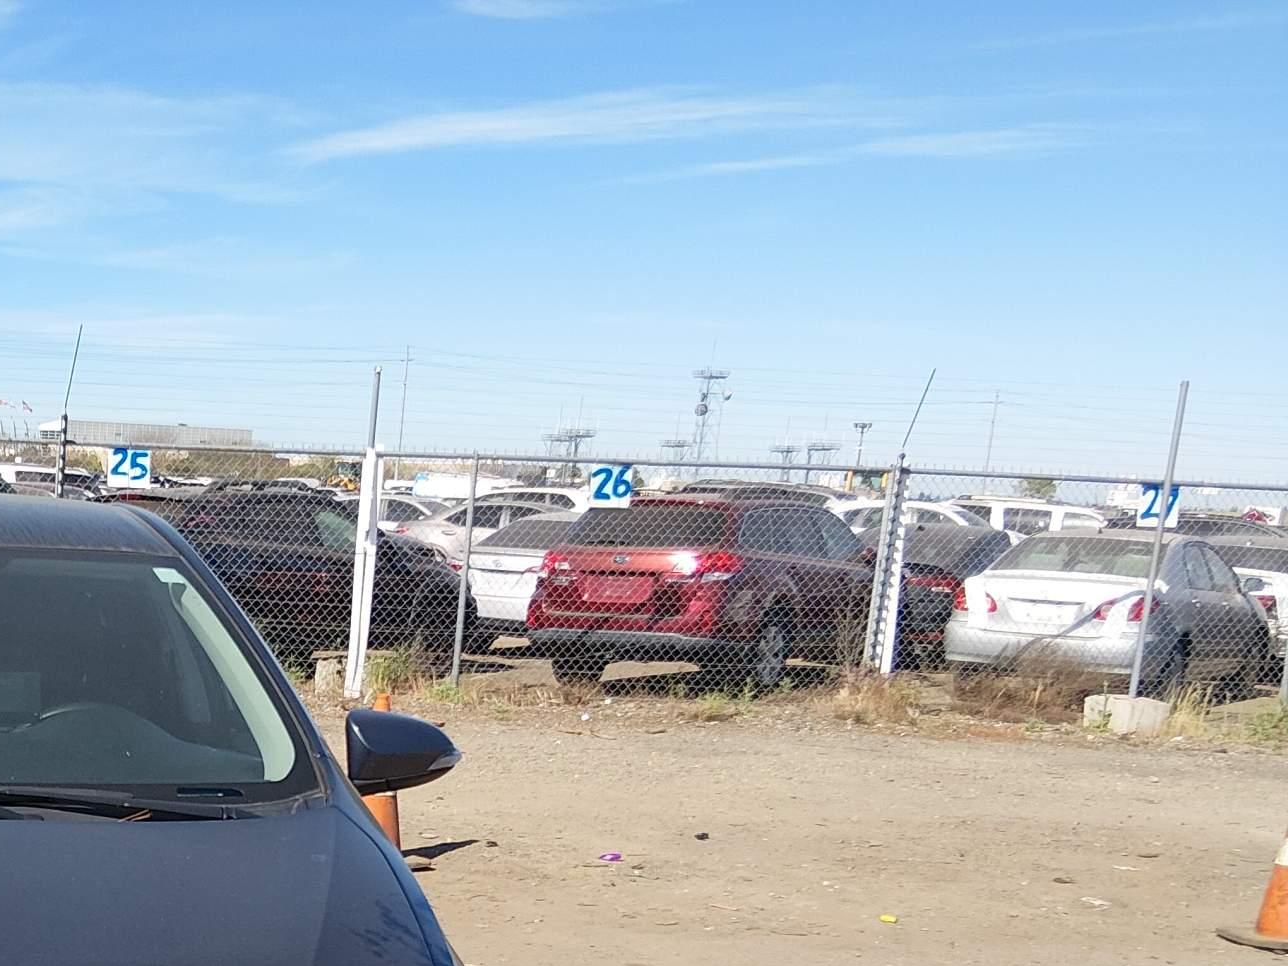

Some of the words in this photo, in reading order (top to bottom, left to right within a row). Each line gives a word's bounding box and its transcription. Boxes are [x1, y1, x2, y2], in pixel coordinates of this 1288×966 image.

[110, 447, 149, 481] 25
[592, 464, 633, 500] 26
[1140, 483, 1179, 521] 27
